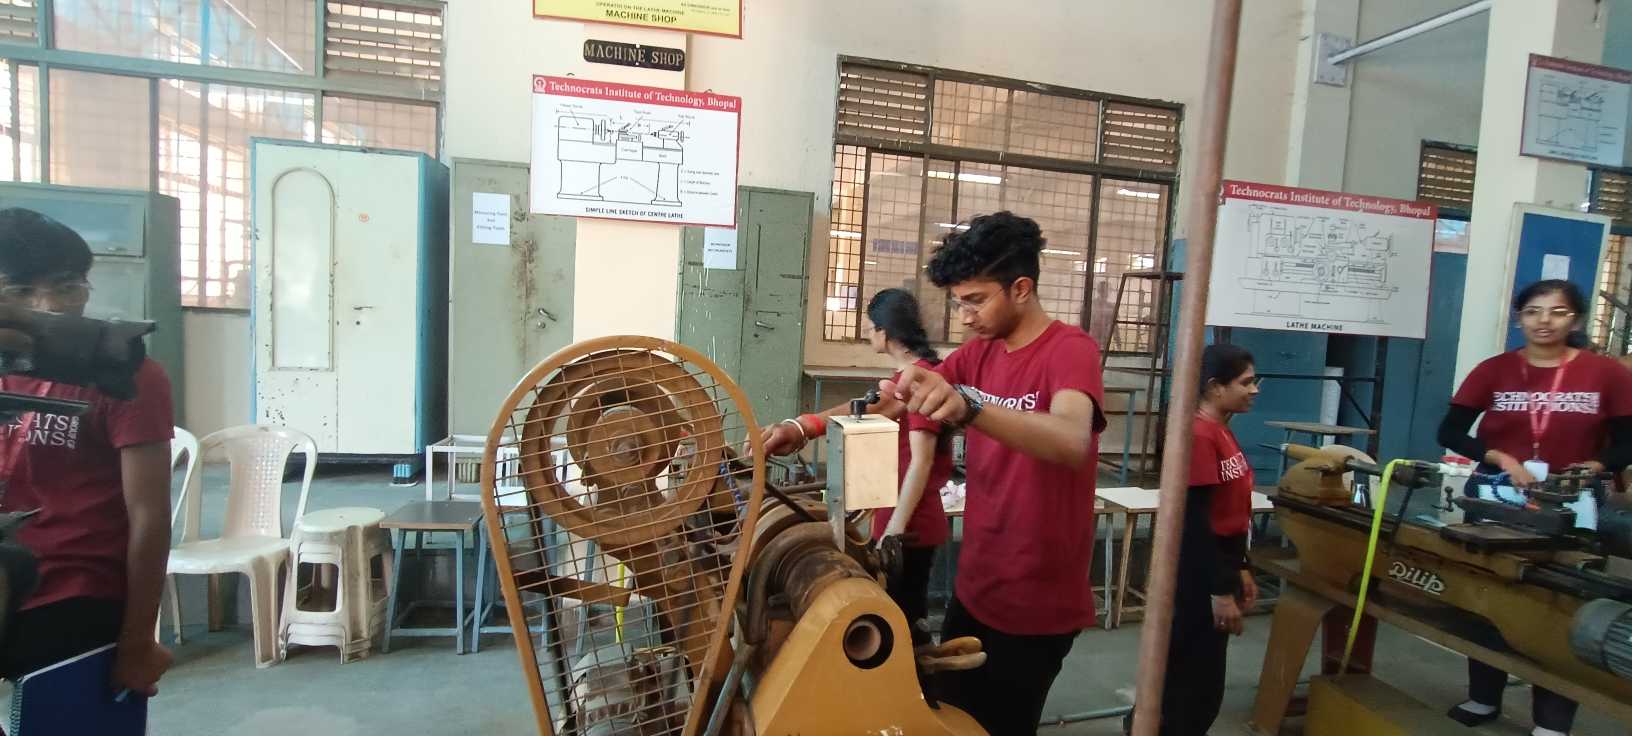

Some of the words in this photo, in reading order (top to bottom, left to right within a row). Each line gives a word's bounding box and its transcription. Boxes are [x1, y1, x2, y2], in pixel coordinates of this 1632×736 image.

[605, 9, 649, 22] MACHINE
[651, 14, 677, 24] SHOP
[584, 43, 646, 63] MACHINE
[651, 51, 684, 67] SHOP
[549, 81, 603, 96] Technocrats
[605, 87, 642, 100] Institute
[643, 91, 655, 100] of
[655, 92, 705, 107] Technology,
[707, 97, 737, 110] Bhopal
[1231, 185, 1288, 201] Technocrats
[1290, 191, 1330, 205] Institute
[1331, 194, 1343, 206] of
[1399, 203, 1432, 219] Bhopal
[1286, 321, 1309, 329] LATHE
[1311, 323, 1343, 331] MACHINE
